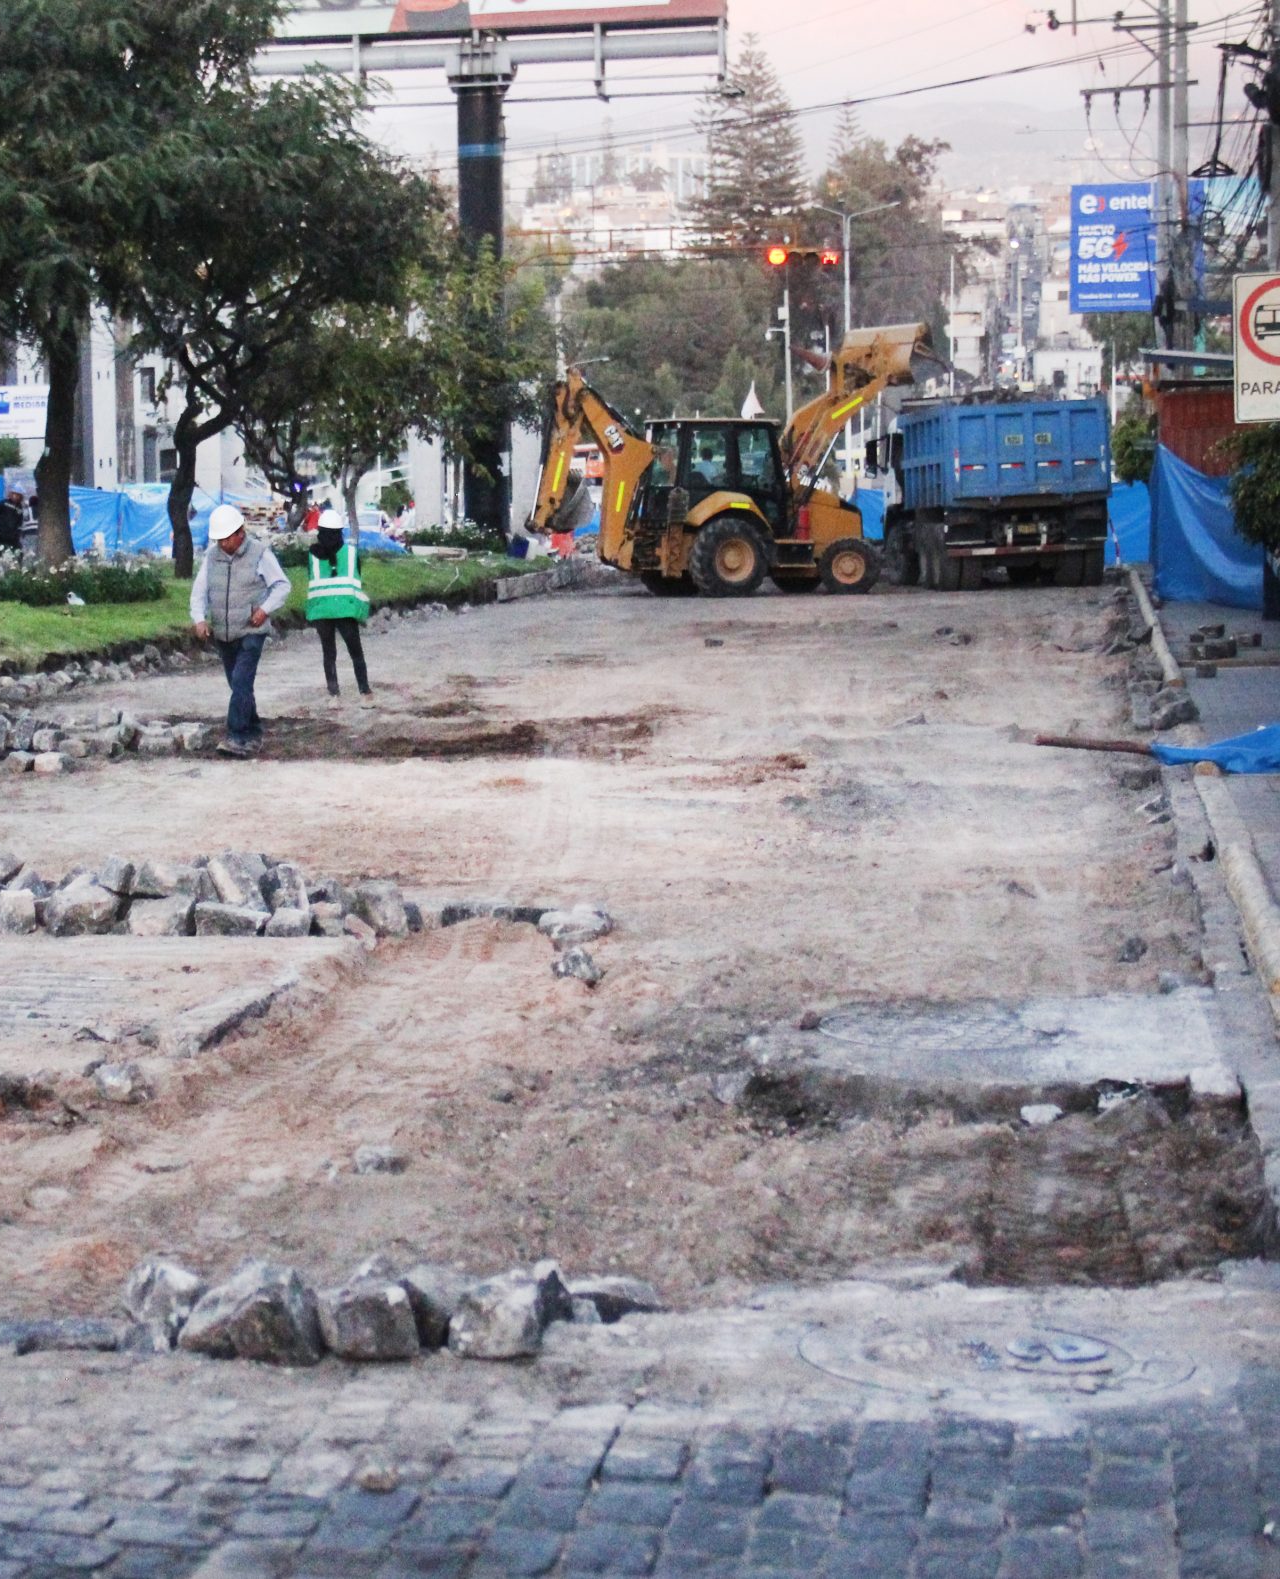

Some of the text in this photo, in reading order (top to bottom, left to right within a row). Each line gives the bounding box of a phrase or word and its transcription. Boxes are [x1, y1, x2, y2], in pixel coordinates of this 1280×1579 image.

[1109, 194, 1154, 210] entel
[1078, 224, 1115, 236] NUEVO
[1078, 236, 1114, 259] 5G
[1078, 262, 1156, 274] MÁS VELOCIDA
[1078, 273, 1100, 284] MÁS
[604, 425, 624, 449] CAT
